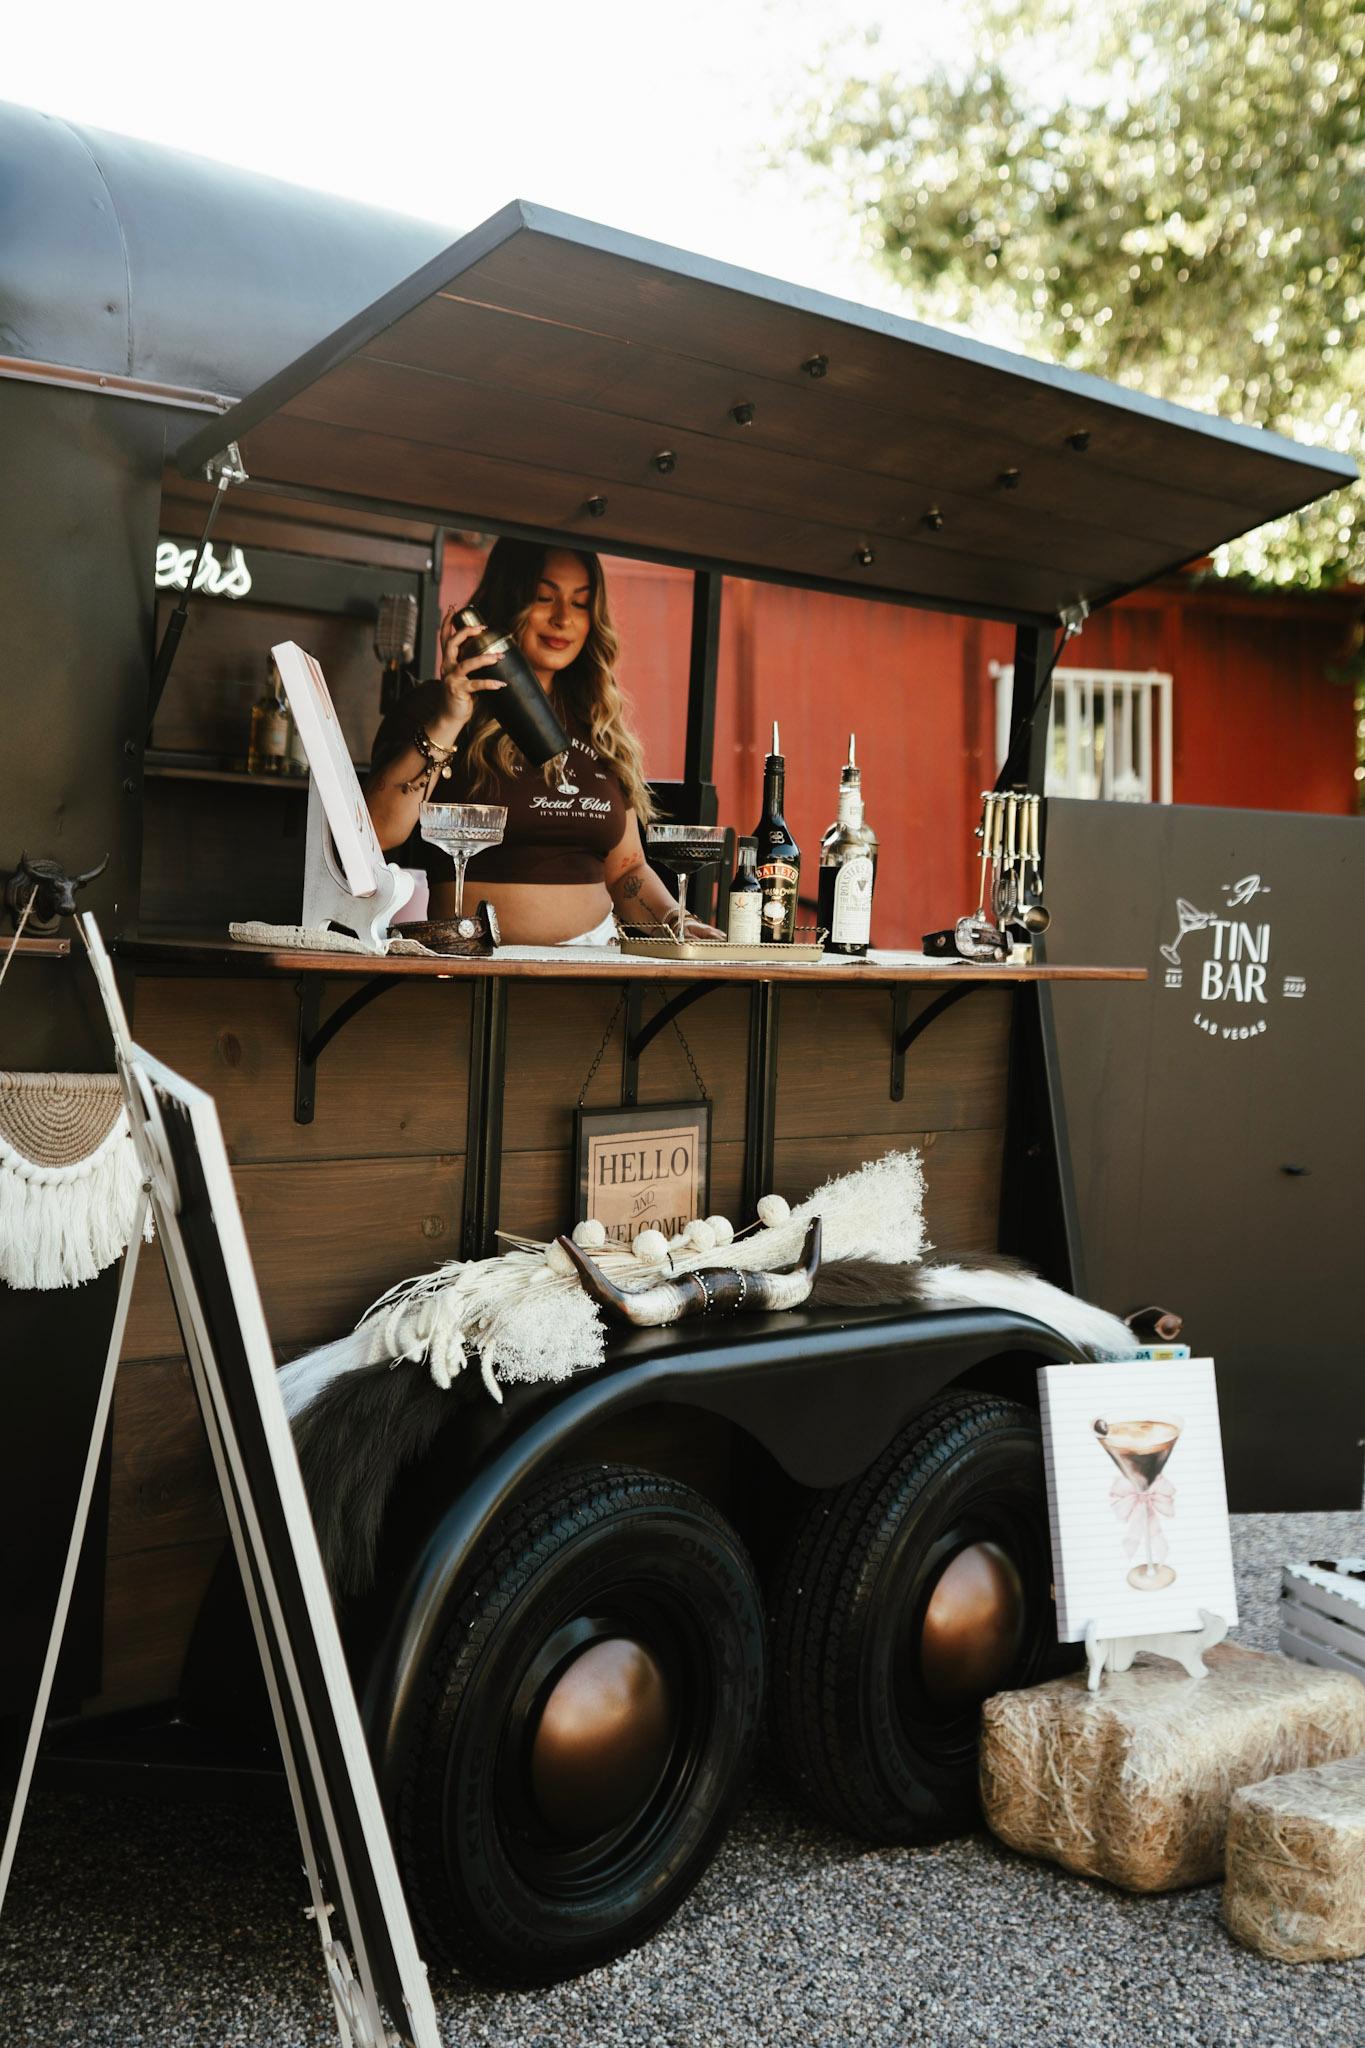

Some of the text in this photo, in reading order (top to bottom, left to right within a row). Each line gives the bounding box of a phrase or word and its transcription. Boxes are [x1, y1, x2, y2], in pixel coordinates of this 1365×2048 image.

[154, 541, 252, 598] eers
[571, 738, 599, 760] RTINI
[529, 796, 611, 812] Social Club
[755, 865, 796, 879] BAILEYS
[1209, 919, 1270, 964] TINI
[1201, 960, 1268, 1004] BAR
[1193, 1012, 1267, 1040] LAS VEGAS
[599, 1146, 689, 1186] HELLO
[632, 1190, 655, 1213] AND
